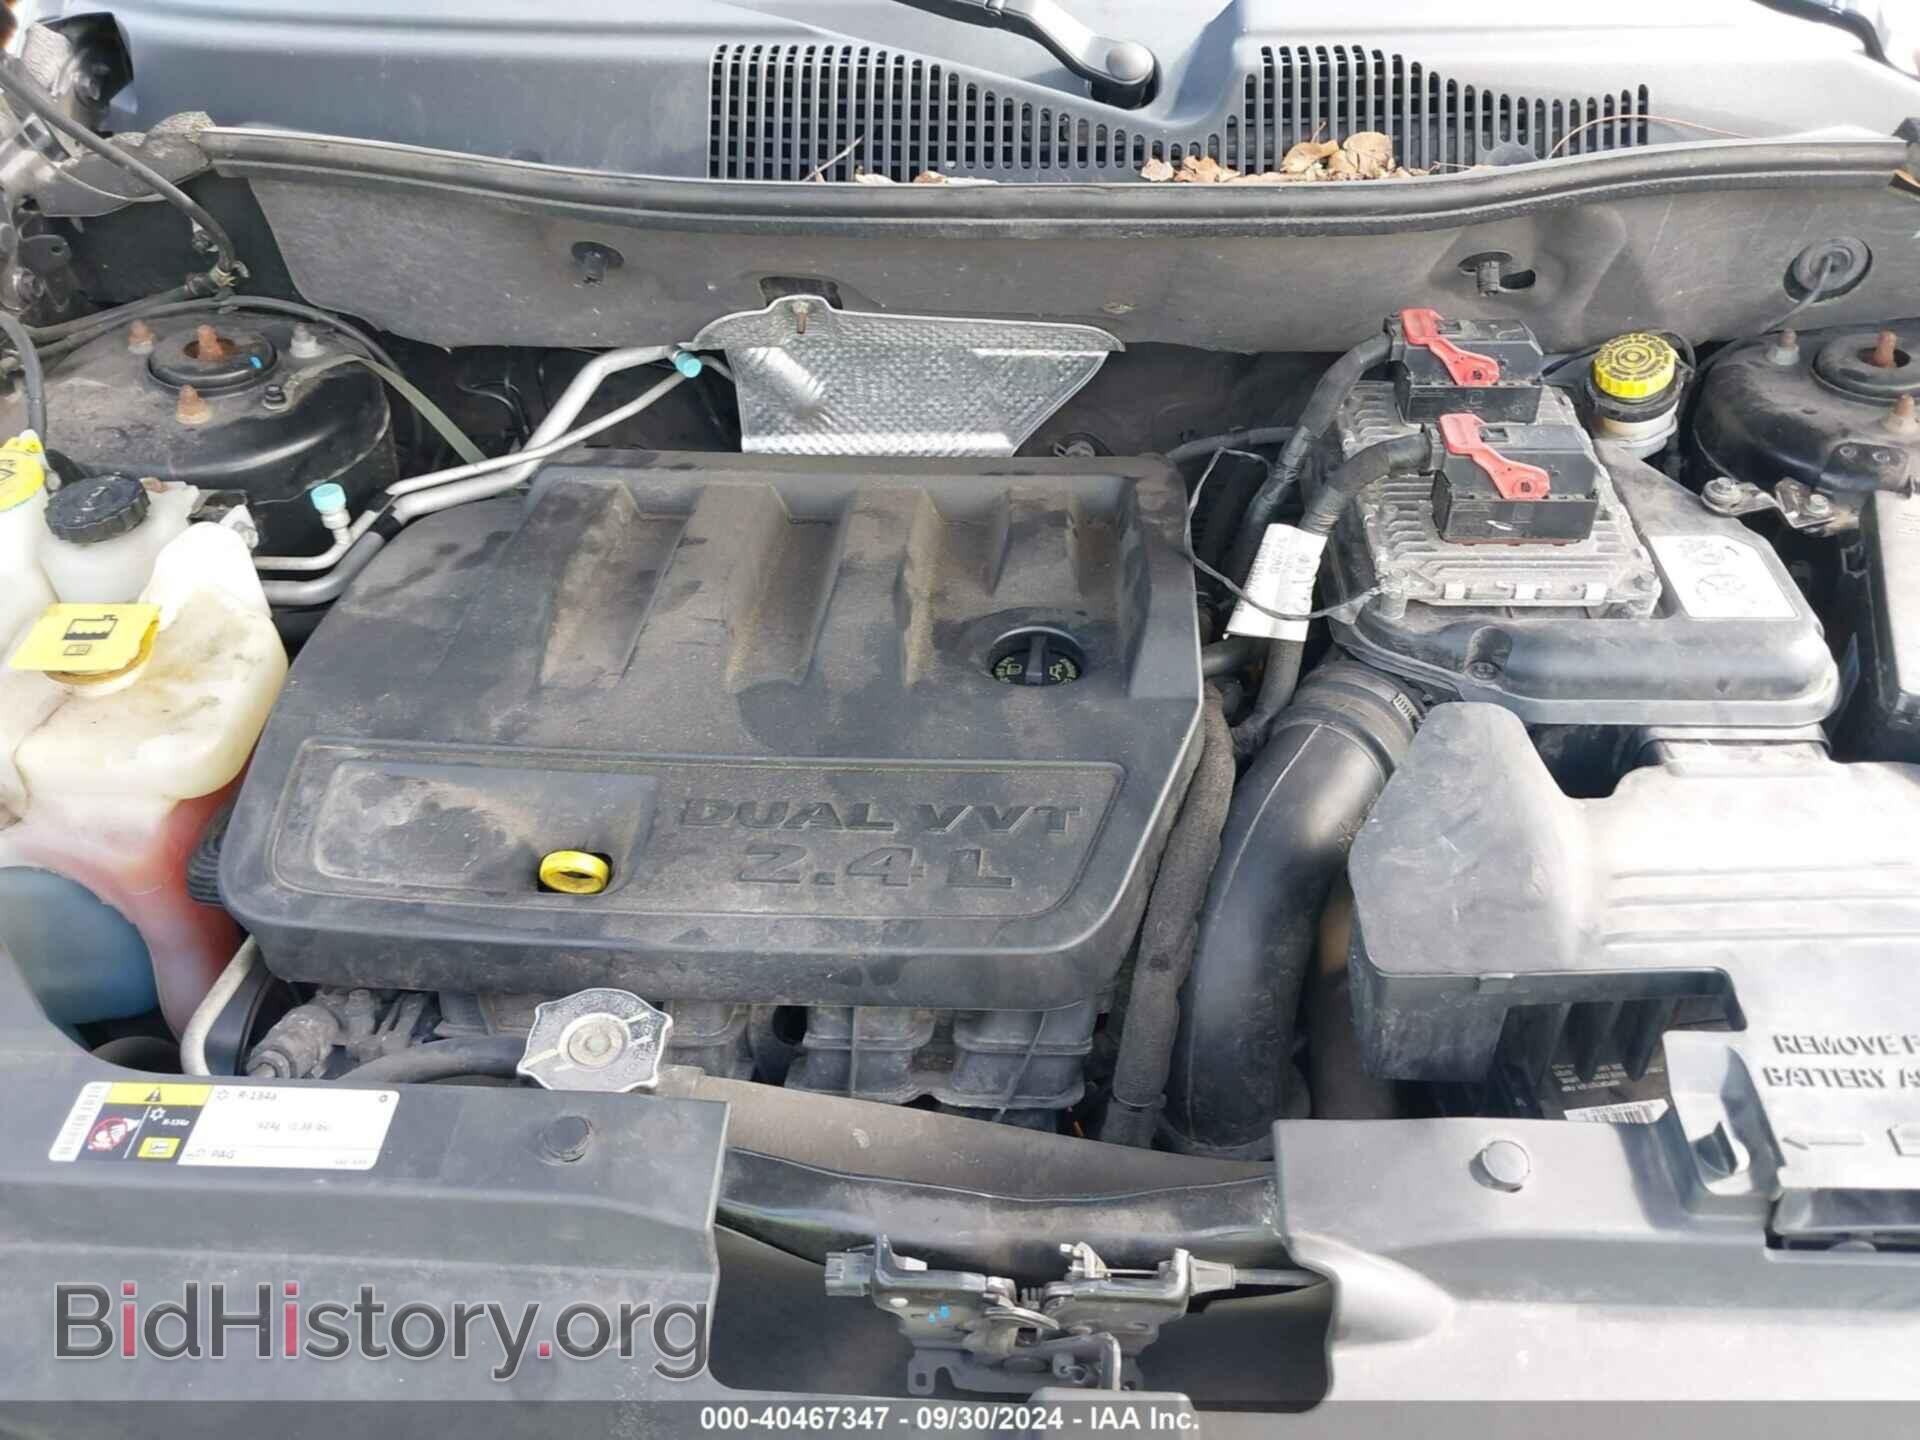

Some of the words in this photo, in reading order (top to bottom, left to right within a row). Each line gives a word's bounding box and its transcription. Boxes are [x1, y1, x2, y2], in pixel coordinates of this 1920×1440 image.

[681, 800, 898, 833] DUAL
[915, 804, 1084, 834] VVT
[1771, 1033, 1900, 1056] REMOVE
[1762, 1066, 1886, 1089] BATTERY
